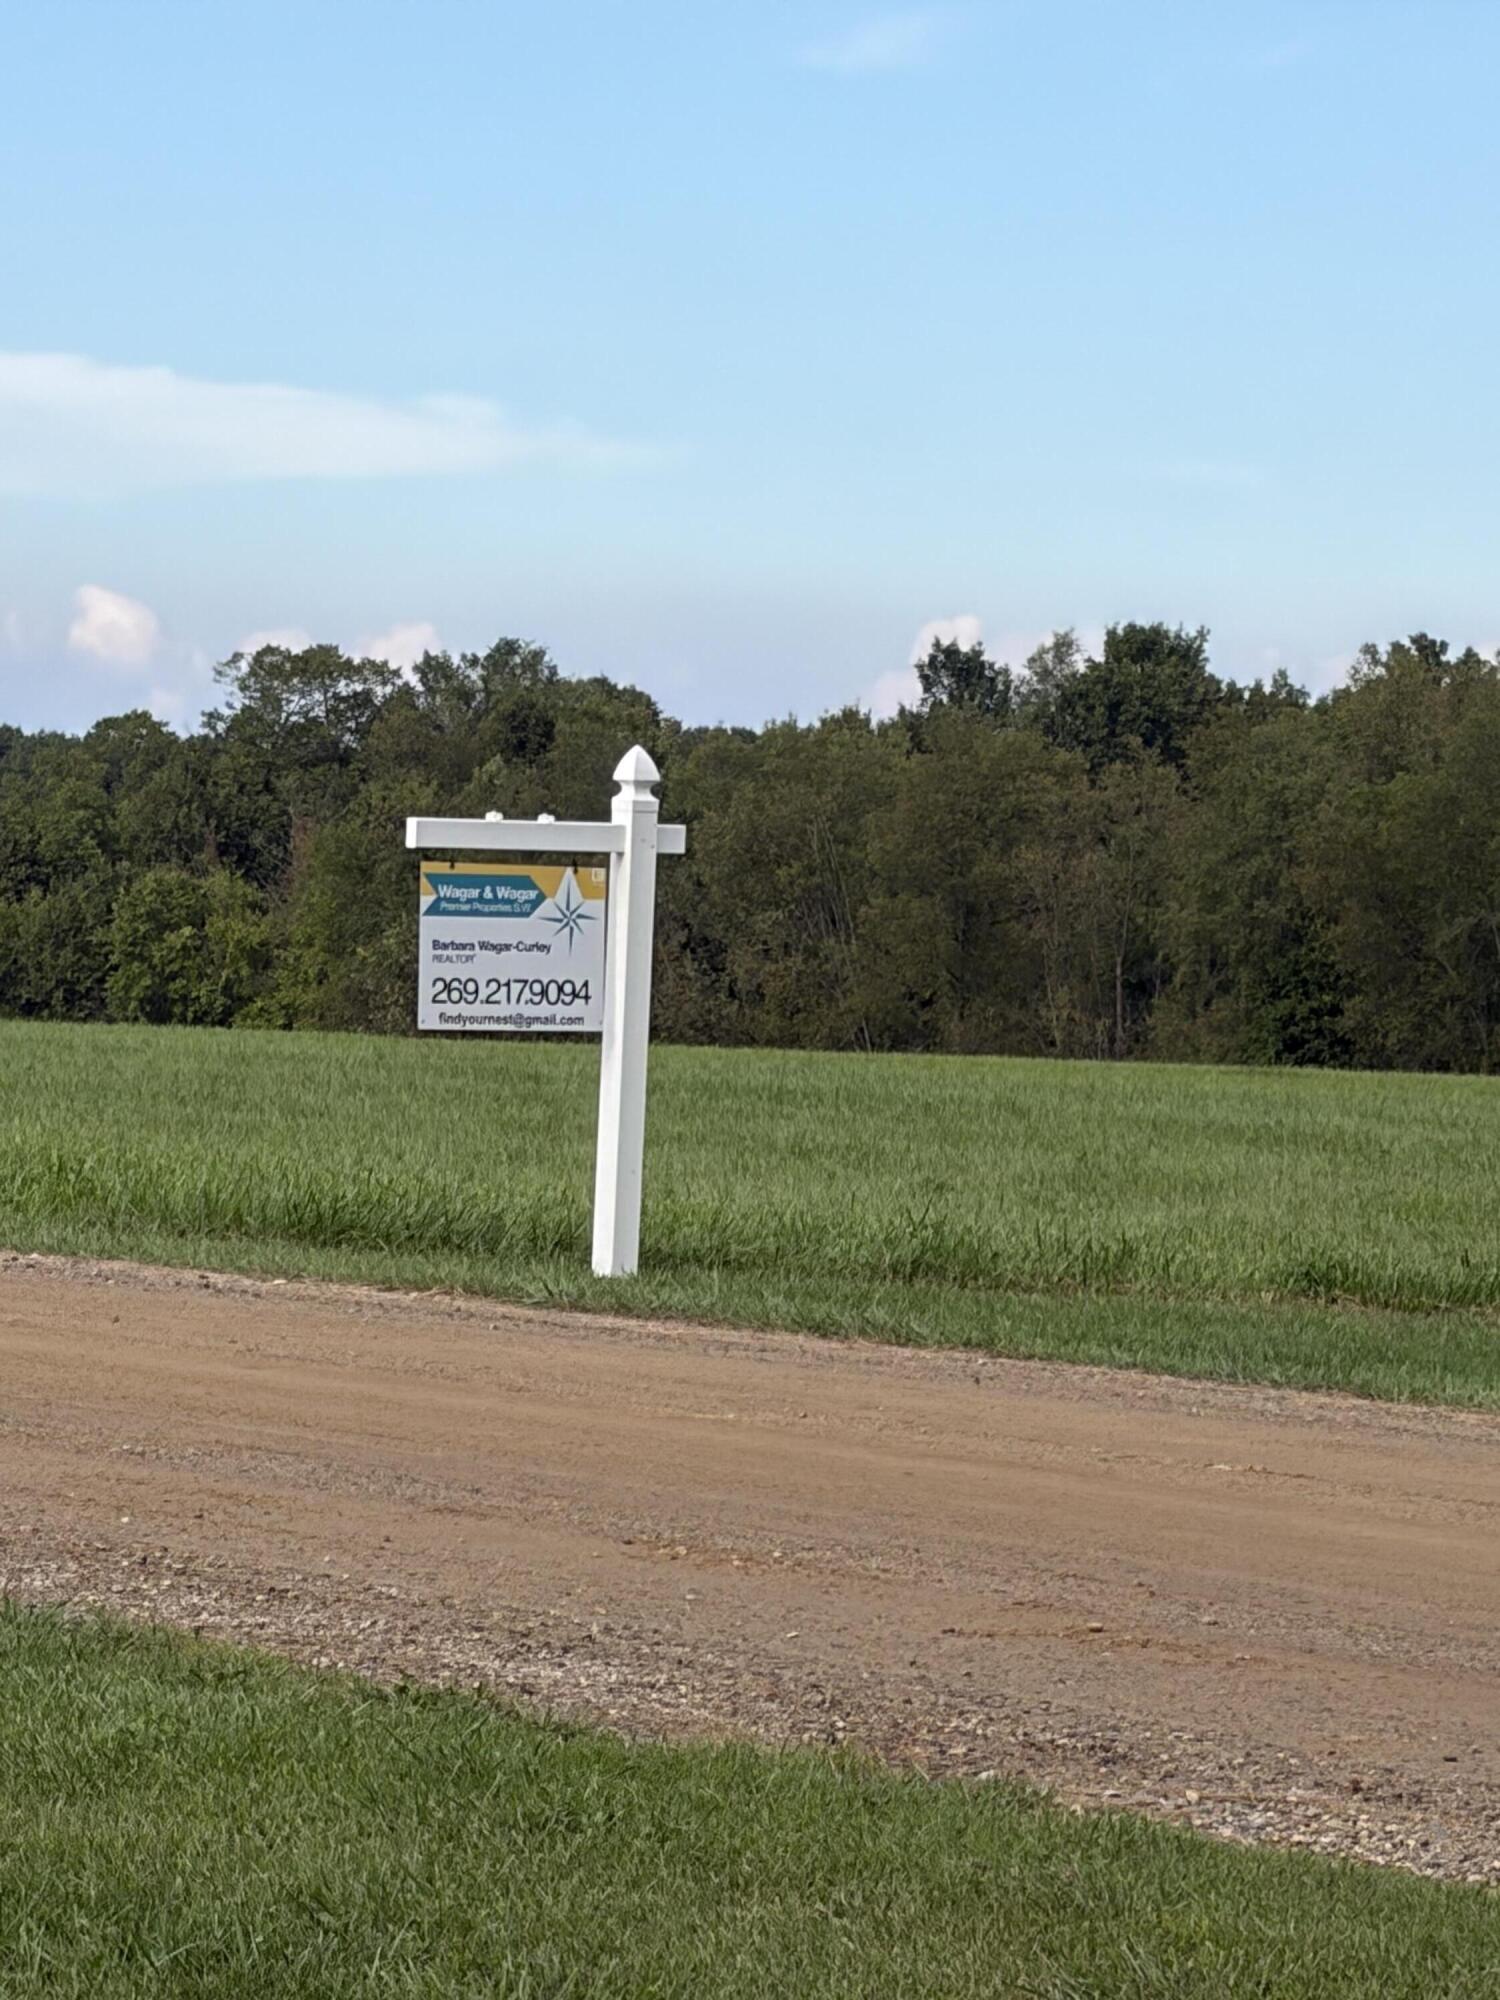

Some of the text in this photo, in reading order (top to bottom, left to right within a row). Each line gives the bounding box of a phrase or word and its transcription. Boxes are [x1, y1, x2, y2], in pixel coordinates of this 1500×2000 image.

[437, 884, 539, 902] Wagar & Wagar
[432, 939, 552, 954] Barbara Wagar-Curley
[431, 977, 592, 1006] 269.217.9094
[438, 1012, 585, 1028] findyournest@gmail.com
